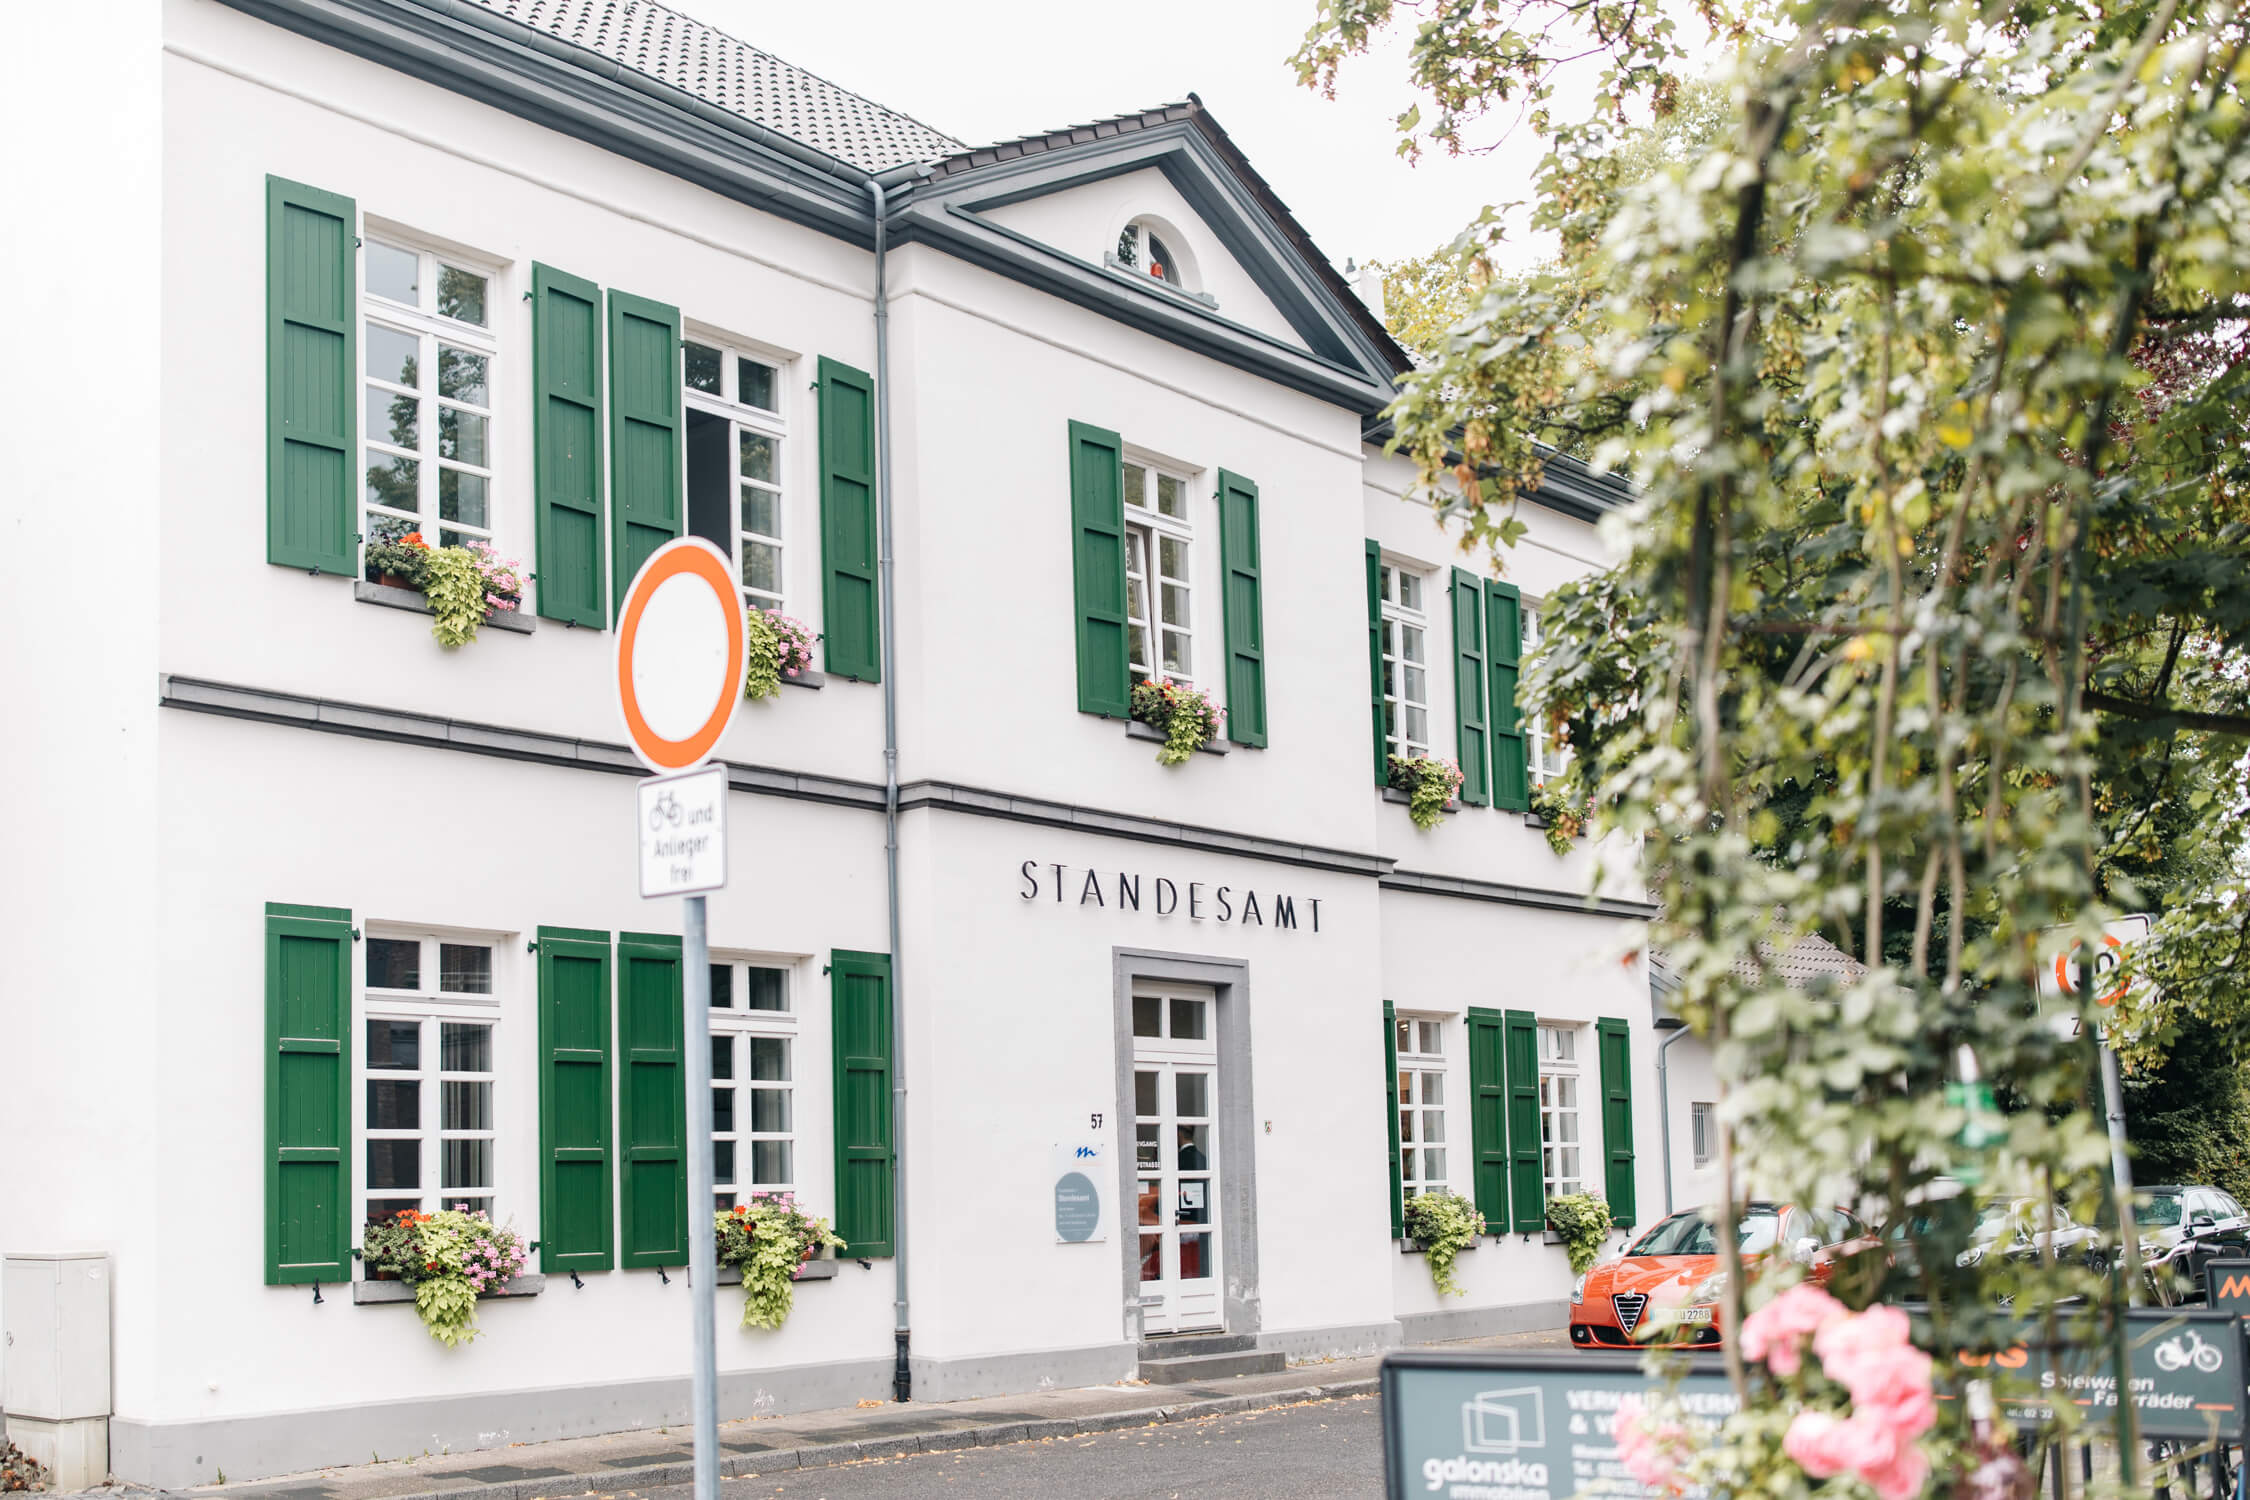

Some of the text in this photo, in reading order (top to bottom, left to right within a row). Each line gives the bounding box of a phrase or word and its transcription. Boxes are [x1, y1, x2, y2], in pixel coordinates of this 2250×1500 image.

[688, 803, 713, 826] und
[654, 834, 709, 860] Anlieger
[670, 863, 693, 883] frei
[1020, 859, 1323, 933] STANDESAMT
[1090, 1113, 1103, 1129] 57
[2094, 1392, 2195, 1410] Farräder
[1423, 1455, 1549, 1491] galonska
